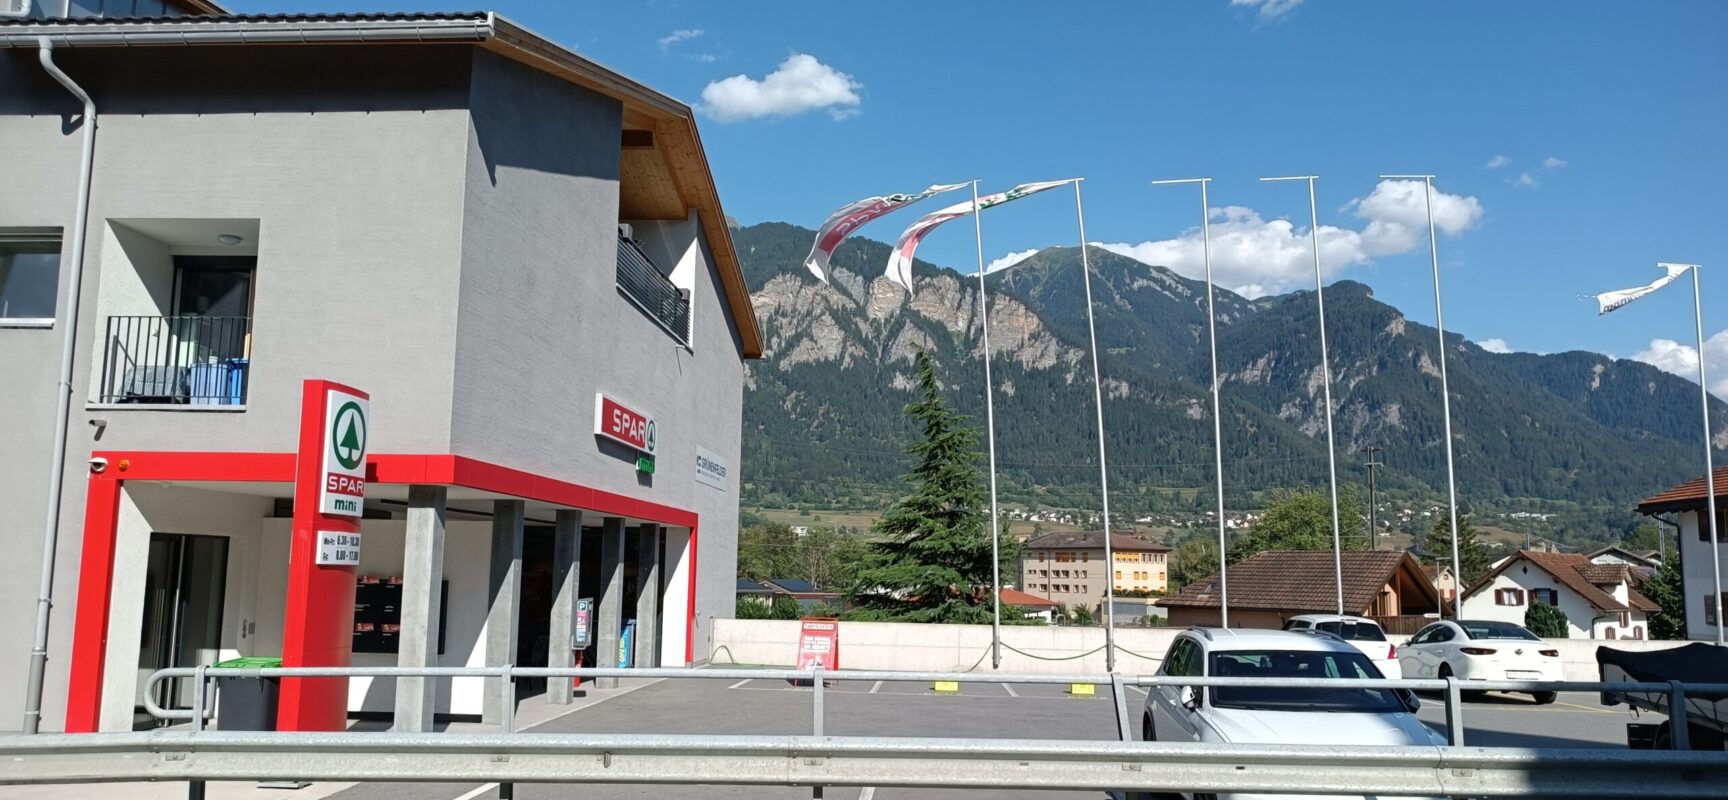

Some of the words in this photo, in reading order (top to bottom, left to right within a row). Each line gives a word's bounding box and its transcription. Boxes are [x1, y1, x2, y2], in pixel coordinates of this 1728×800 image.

[613, 408, 646, 444] SPAR
[328, 476, 364, 494] SPAR
[334, 499, 357, 512] mini
